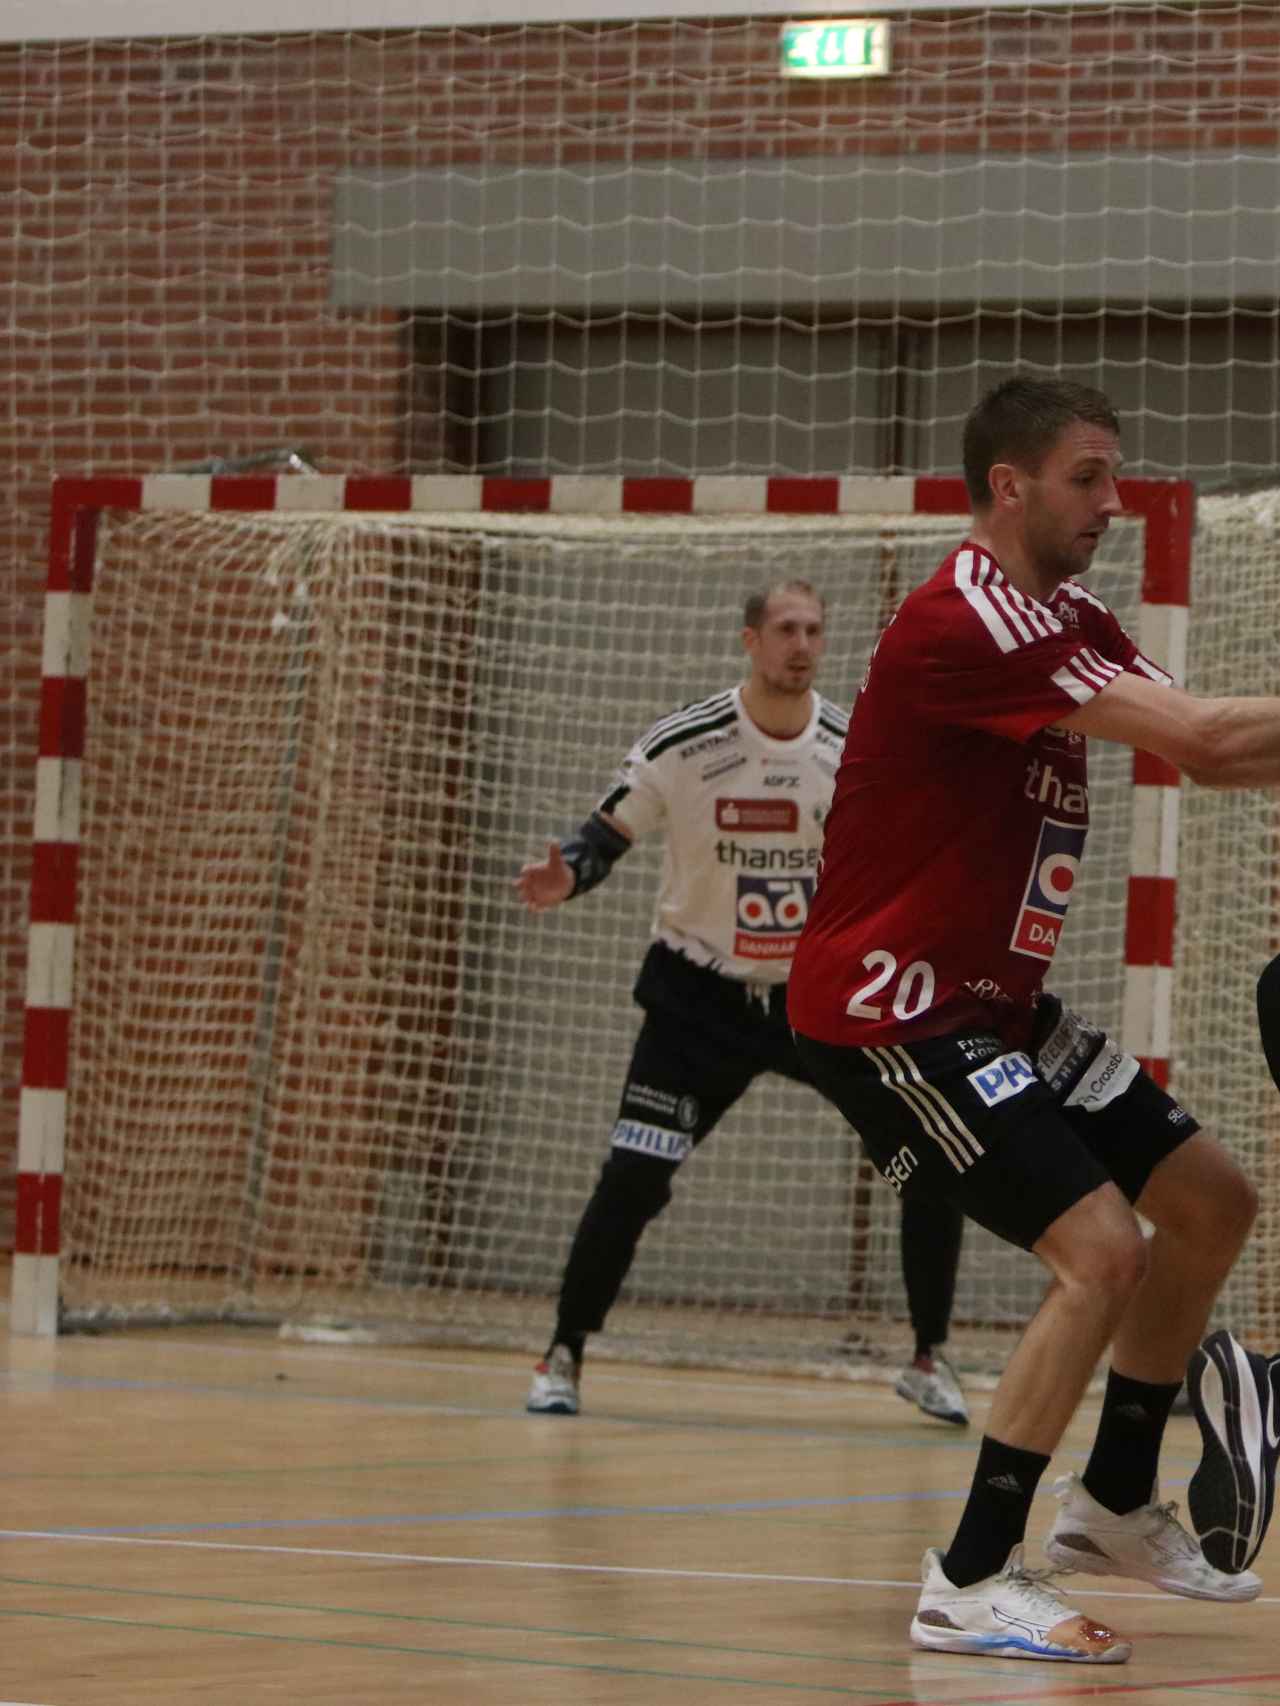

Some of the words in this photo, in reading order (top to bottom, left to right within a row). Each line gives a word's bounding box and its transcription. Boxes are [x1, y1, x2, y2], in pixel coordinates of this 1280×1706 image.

[715, 839, 818, 869] thanse
[846, 949, 936, 1021] 20
[975, 1057, 1036, 1099] PH
[1090, 1050, 1124, 1095] Crossb
